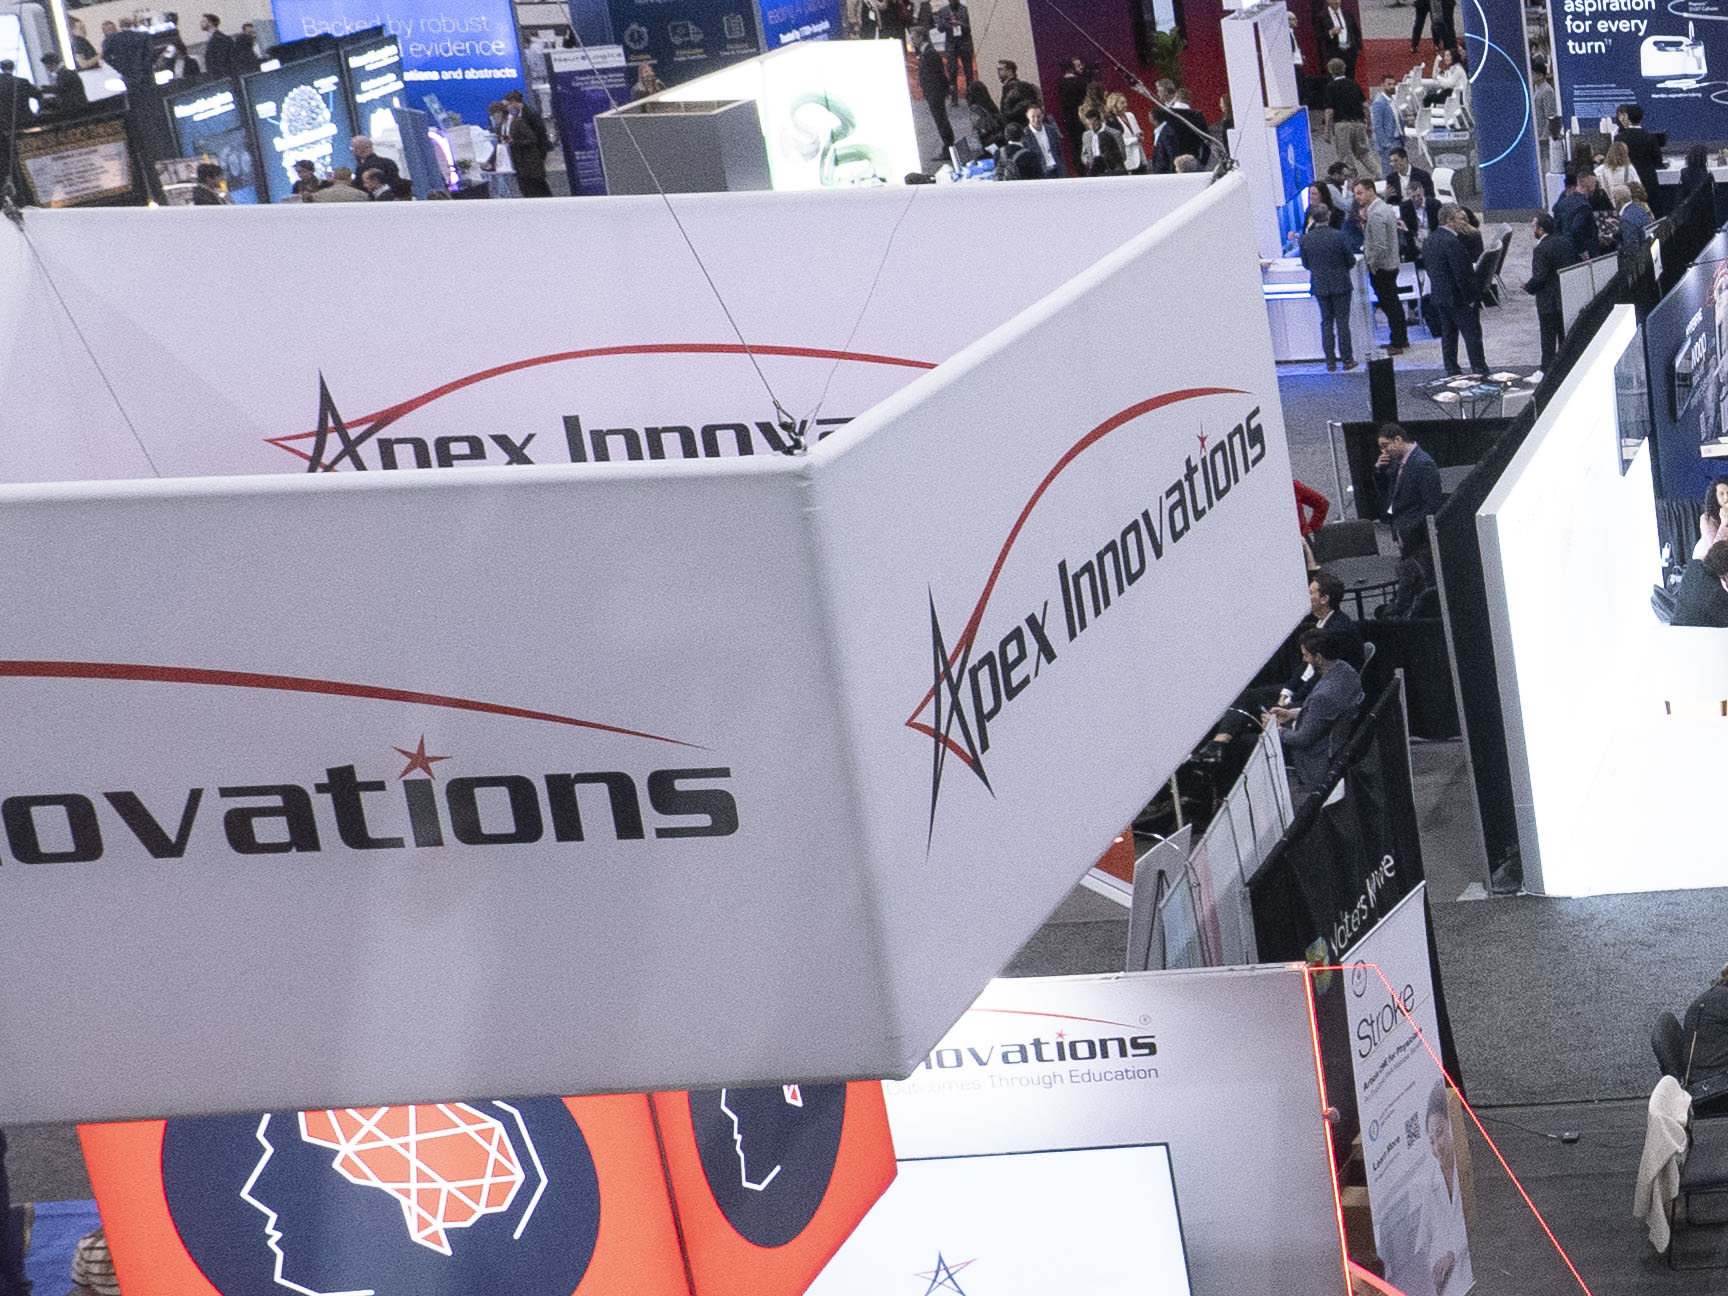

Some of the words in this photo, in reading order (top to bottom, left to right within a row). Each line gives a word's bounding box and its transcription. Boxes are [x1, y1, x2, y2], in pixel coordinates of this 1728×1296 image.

[301, 15, 382, 38] Backed
[386, 15, 414, 38] by
[420, 13, 490, 33] robust
[1565, 15, 1591, 34] for
[1596, 19, 1648, 37] every
[408, 37, 507, 57] evidence
[441, 68, 464, 80] and
[464, 66, 519, 81] abstracts
[1060, 404, 1267, 642] Innovations
[0, 736, 741, 868] ovations
[1356, 983, 1415, 1060] Stroke
[988, 1071, 1065, 1092] Through
[1069, 1065, 1160, 1086] Education
